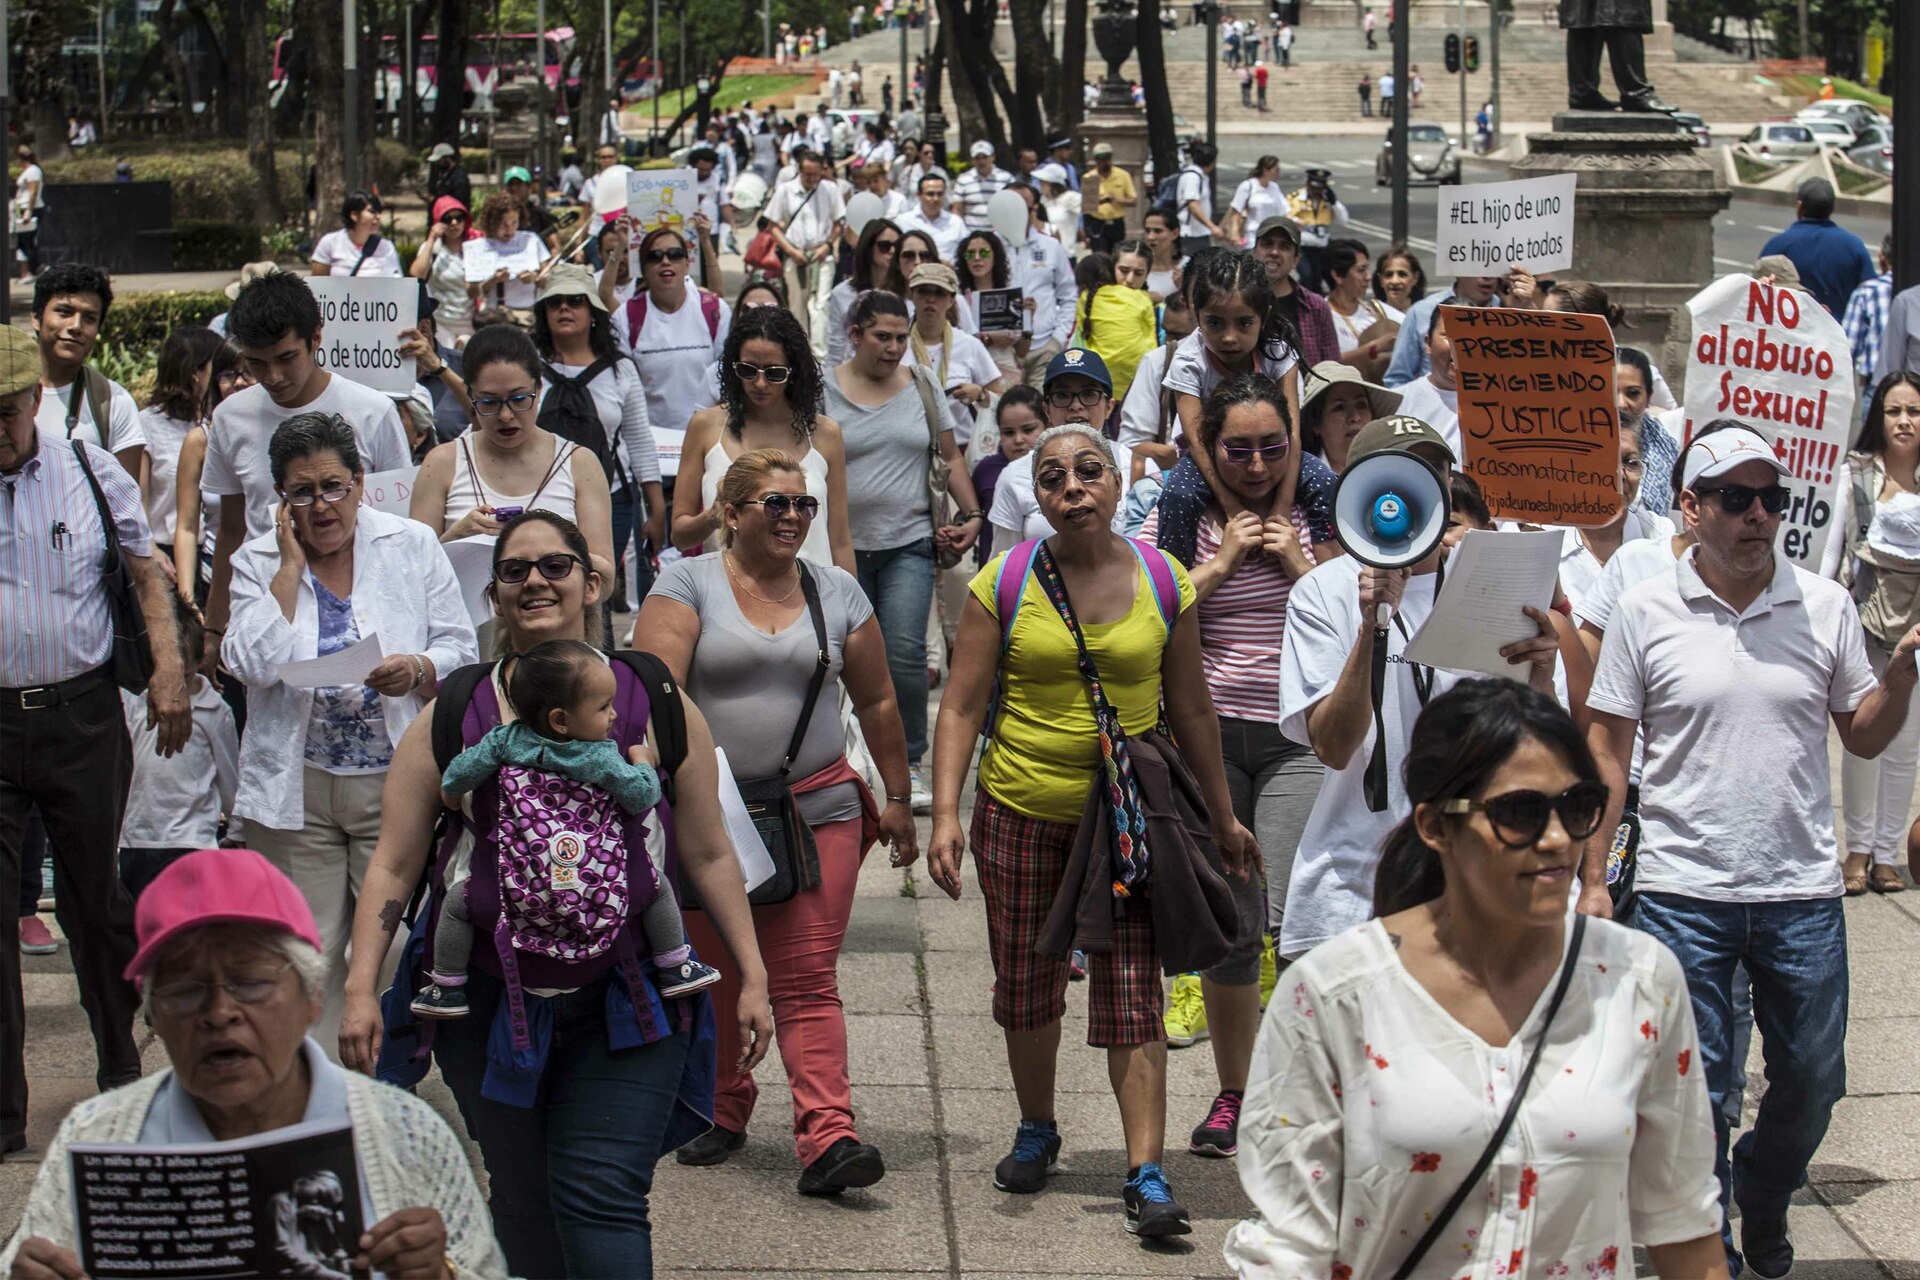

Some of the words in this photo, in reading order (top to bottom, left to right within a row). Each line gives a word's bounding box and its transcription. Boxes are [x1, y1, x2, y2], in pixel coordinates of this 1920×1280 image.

[1451, 201, 1478, 224] #EL
[1483, 199, 1511, 229] hijo
[1515, 195, 1532, 220] de
[1536, 196, 1560, 217] uno
[1449, 244, 1466, 261] es
[1471, 239, 1501, 267] hijo
[1506, 237, 1524, 262] de
[1527, 231, 1562, 259] todos
[318, 294, 336, 328] ijo
[340, 293, 360, 322] de
[364, 302, 398, 322] uno
[1747, 281, 1800, 329] NO
[1455, 309, 1585, 331] PADRES
[331, 339, 350, 368] de
[353, 340, 401, 369] todos
[1455, 337, 1615, 364] PRESENTES
[1697, 324, 1728, 365] al
[1733, 329, 1833, 380] abuso
[1461, 371, 1606, 392] EXIGIENDO
[1718, 370, 1828, 430] Sexual
[1387, 417, 1425, 435] 72
[1469, 401, 1613, 439] JUSTICIA
[1784, 529, 1812, 560] es
[83, 1155, 101, 1166] Un
[103, 1154, 132, 1167] niño
[134, 1156, 151, 1167] de
[154, 1156, 164, 1167] 3
[165, 1155, 197, 1167] años
[201, 1153, 245, 1167] apenas
[85, 1172, 99, 1181] es
[104, 1172, 141, 1183] capaz
[146, 1170, 163, 1182] de
[168, 1170, 223, 1183] pedalear
[229, 1168, 247, 1178] un
[141, 1187, 170, 1198] pero
[180, 1184, 219, 1197] según
[229, 1182, 249, 1192] las
[87, 1200, 119, 1212] leyes
[123, 1201, 187, 1211] mexicanas
[191, 1198, 224, 1210] debe
[229, 1197, 250, 1207] ser
[90, 1213, 178, 1226] perfectamente
[186, 1213, 225, 1225] capaz
[233, 1210, 252, 1221] de
[91, 1228, 139, 1239] declarar
[142, 1229, 170, 1239] ante
[173, 1231, 190, 1239] un
[191, 1224, 254, 1238] Ministerio
[93, 1242, 138, 1254] Público
[150, 1243, 164, 1254] al
[176, 1243, 213, 1254] haber
[227, 1238, 255, 1250] sido
[95, 1257, 152, 1269] abusado
